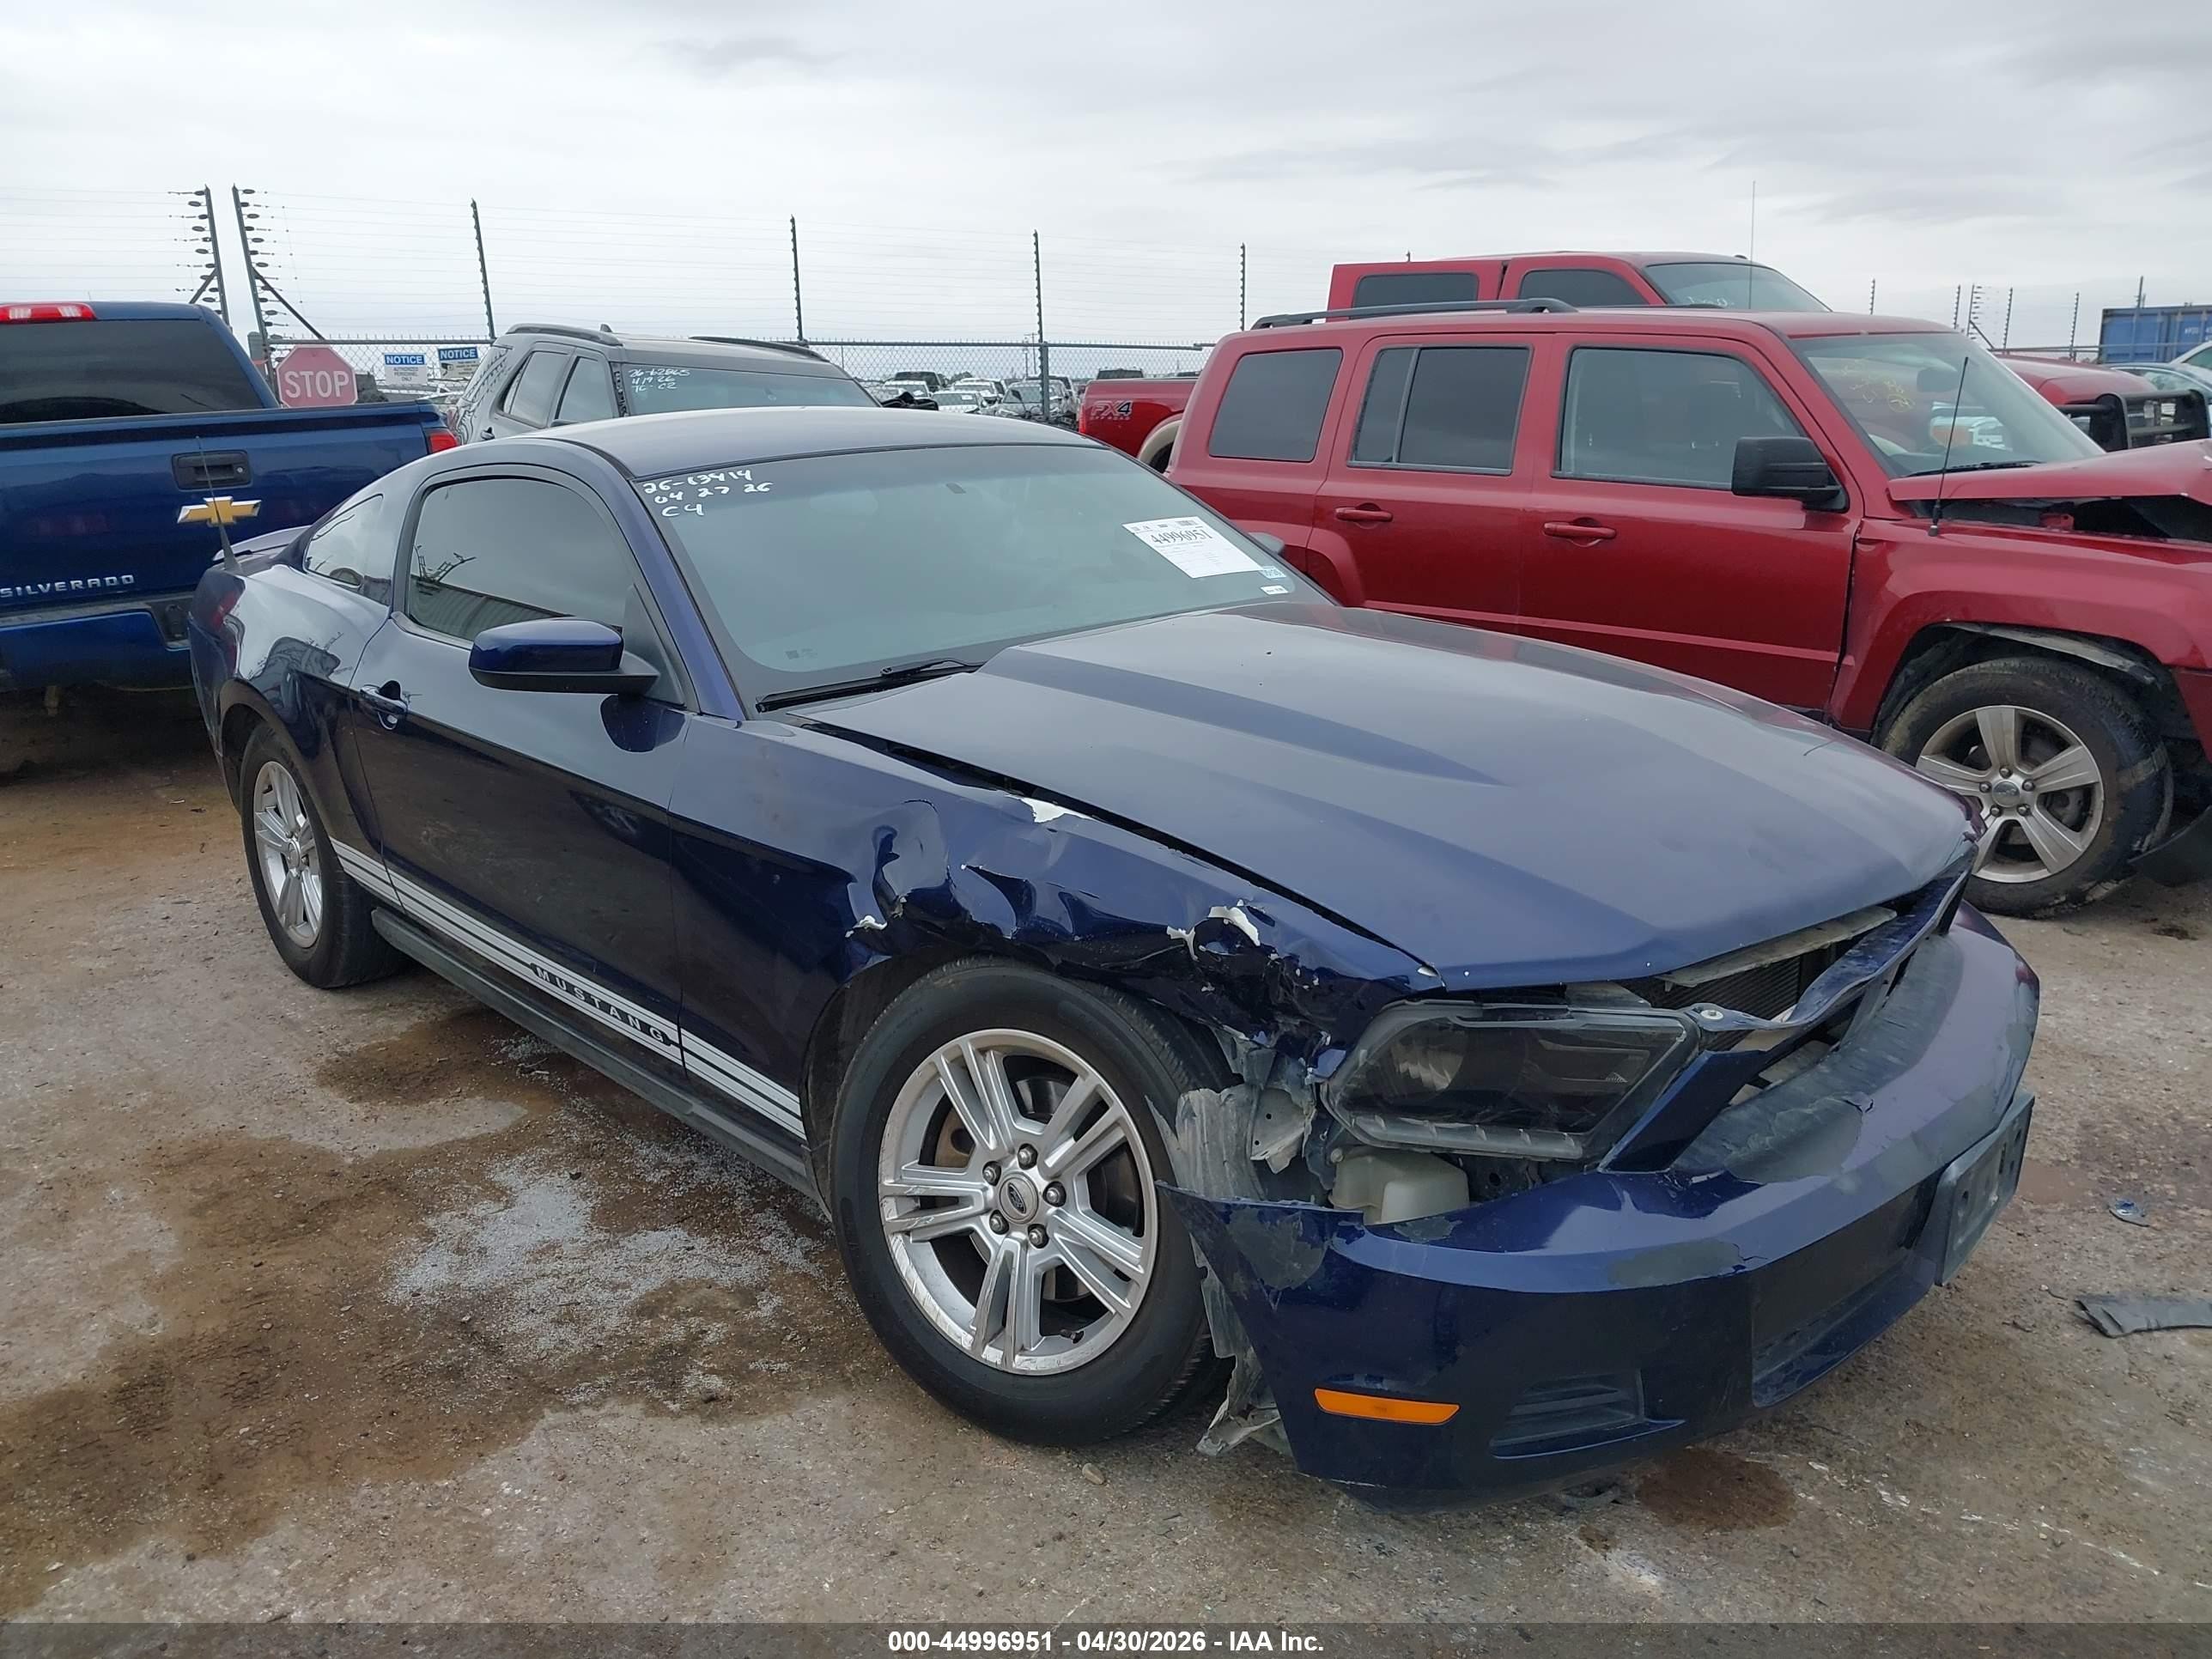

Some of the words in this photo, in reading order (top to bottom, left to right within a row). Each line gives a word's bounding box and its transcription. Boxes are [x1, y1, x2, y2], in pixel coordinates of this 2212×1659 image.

[386, 355, 424, 365] NOTICE
[440, 348, 477, 360] NOTICE
[284, 371, 349, 398] STOP
[1091, 400, 1133, 417] FX4
[654, 491, 684, 504] 04
[697, 486, 730, 498] 27
[744, 482, 774, 493] 26
[0, 574, 136, 599] SILVERADO
[536, 967, 665, 1043] MUSTANG
